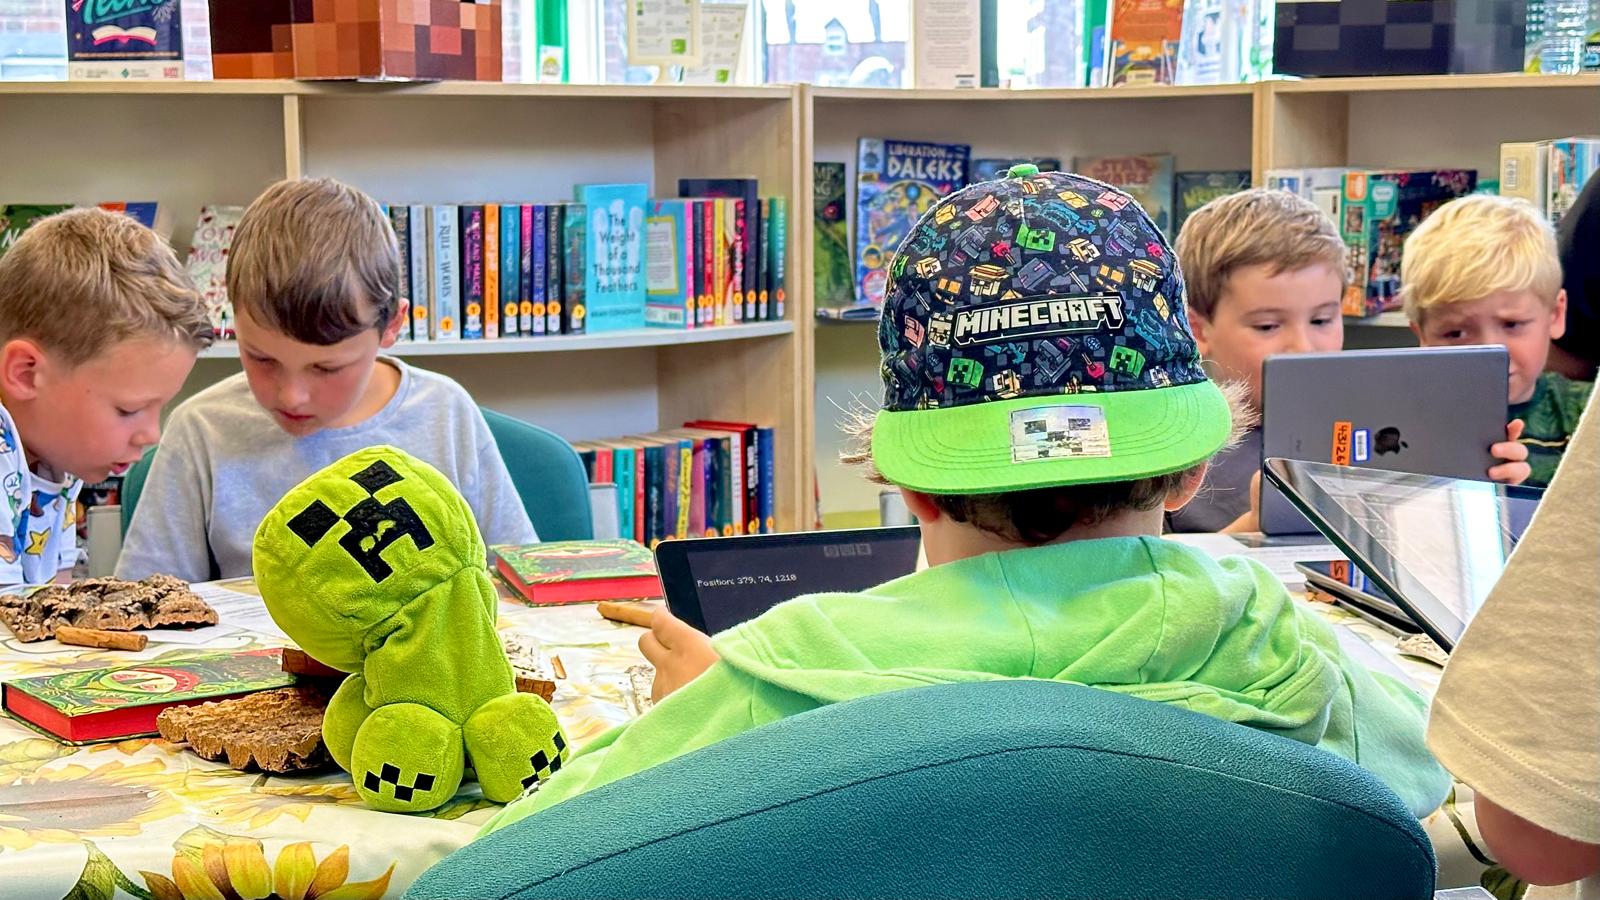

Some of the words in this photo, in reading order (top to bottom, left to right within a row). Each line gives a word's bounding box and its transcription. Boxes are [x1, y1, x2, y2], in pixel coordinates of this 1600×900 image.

[888, 157, 963, 180] DALEKS
[608, 214, 626, 227] The
[599, 231, 636, 247] Weight
[608, 246, 619, 260] of
[593, 261, 640, 277] Thousand
[596, 281, 638, 293] Feathers
[956, 296, 1123, 338] MINECRAFT
[1336, 425, 1348, 465] 43126
[697, 578, 735, 587] Position:
